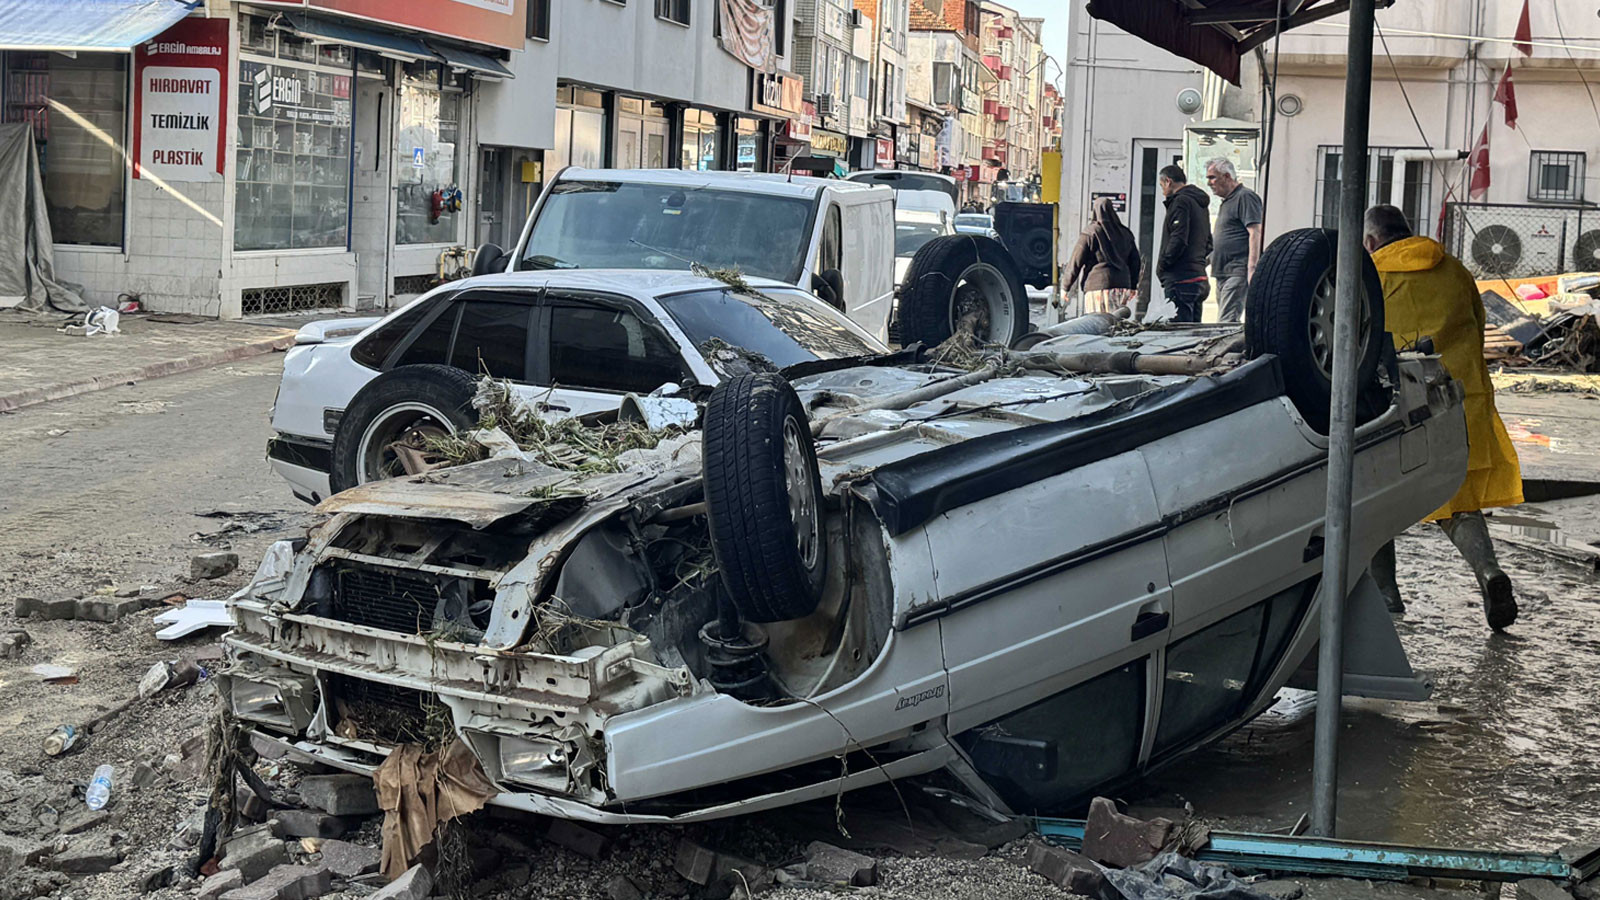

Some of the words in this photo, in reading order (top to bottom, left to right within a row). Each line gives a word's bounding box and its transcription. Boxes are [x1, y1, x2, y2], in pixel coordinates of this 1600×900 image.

[150, 78, 212, 94] HIRDAVAT
[151, 111, 209, 130] TEMİZLİK
[152, 147, 204, 166] PLASTİK
[895, 684, 945, 711] Broadway
